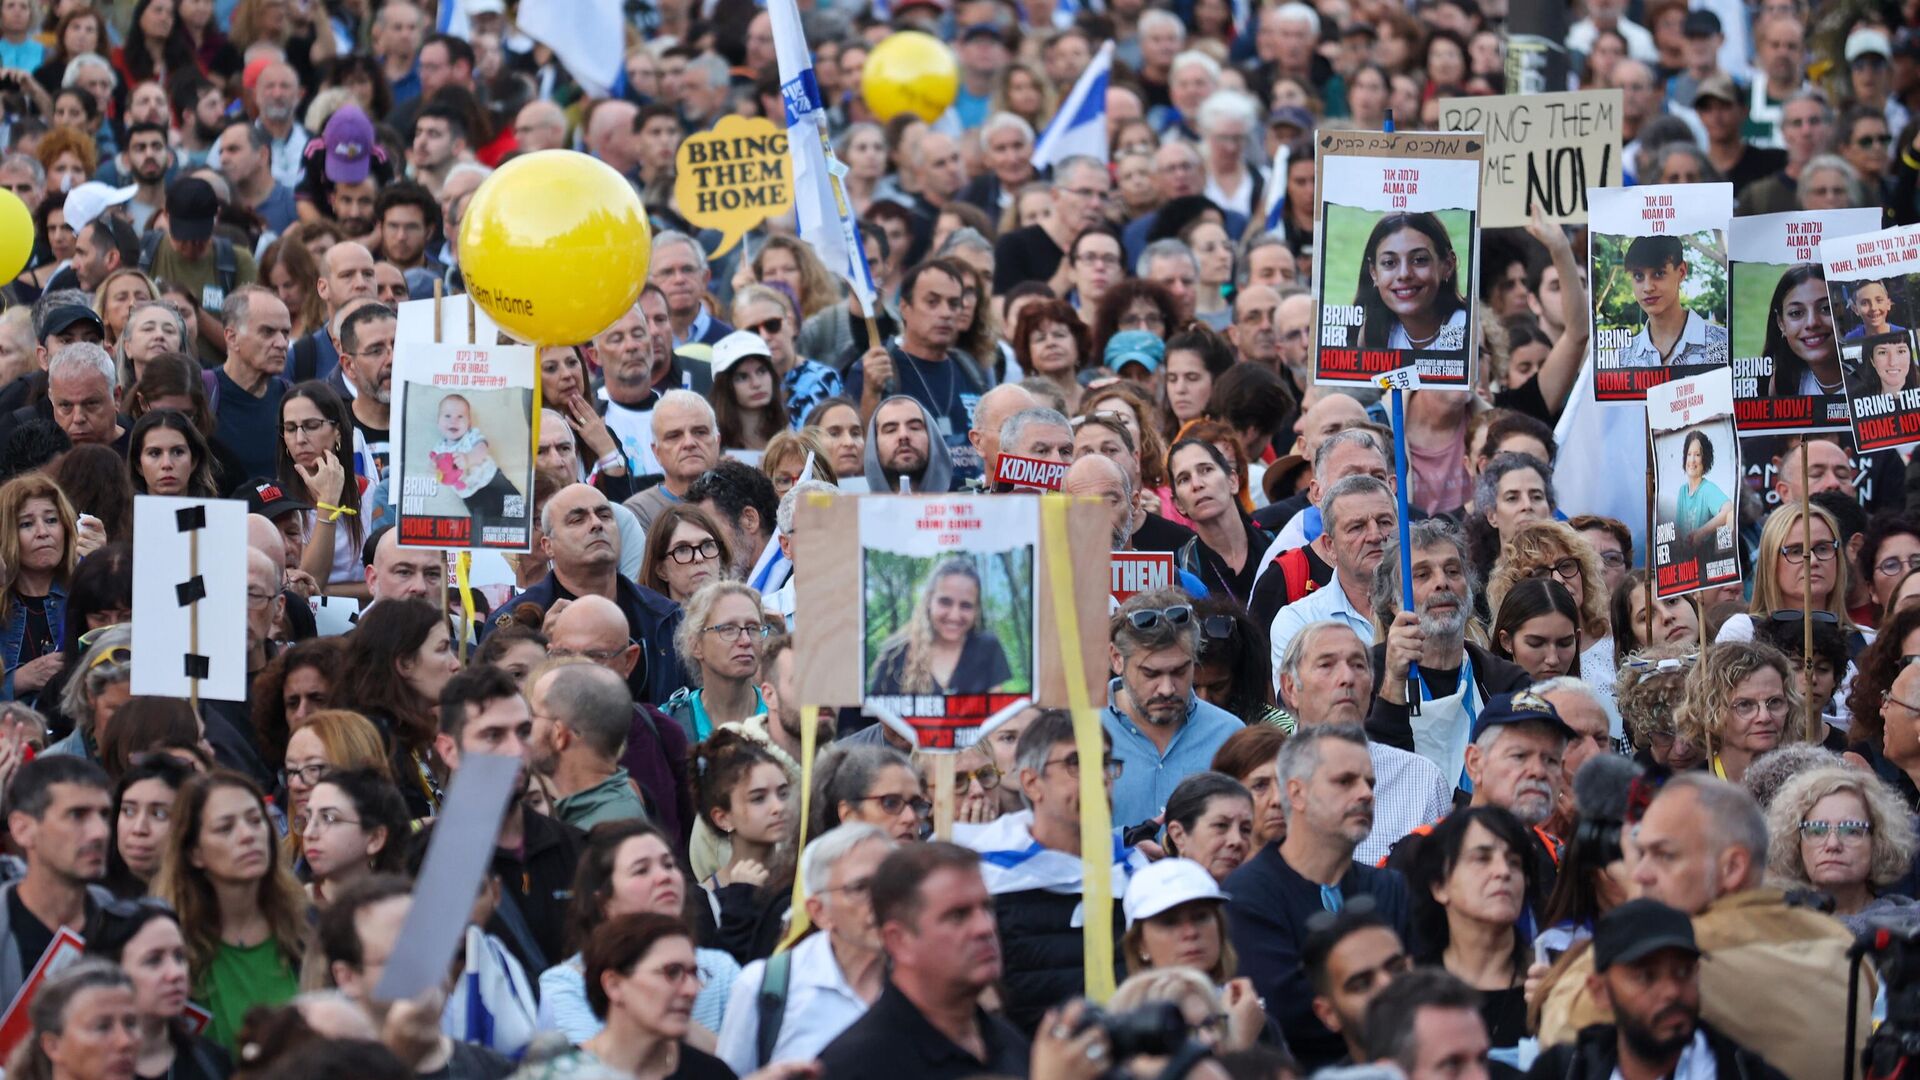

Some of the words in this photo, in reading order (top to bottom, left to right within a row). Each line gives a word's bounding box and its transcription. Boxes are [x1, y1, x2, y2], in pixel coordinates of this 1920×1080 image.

[1545, 102, 1613, 139] THEM
[687, 133, 788, 164] BRING
[1369, 136, 1402, 150] לכם
[692, 158, 784, 188] THEM
[1383, 168, 1396, 181] אור
[1398, 169, 1419, 181] עלמה
[1485, 154, 1516, 186] ME
[697, 183, 788, 213] HOME
[1382, 182, 1405, 194] ALMA
[1406, 183, 1418, 195] OR
[1392, 196, 1407, 208] (13)
[1644, 195, 1657, 207] אור
[1642, 208, 1664, 220] NOAM
[1665, 208, 1676, 219] OR
[1652, 220, 1665, 233] (17)
[1785, 222, 1799, 234] אור
[1801, 221, 1823, 234] עלמה
[1786, 235, 1809, 247] ALMA
[1796, 248, 1812, 261] (13)
[1829, 261, 1857, 274] YAHEL,
[1857, 253, 1886, 270] NAVEH,
[1886, 251, 1901, 264] TAL
[1902, 248, 1918, 261] AND
[493, 287, 534, 316] Home
[1322, 303, 1364, 327] BRING
[1321, 324, 1348, 348] HER
[1597, 328, 1632, 349] BRING
[1320, 349, 1358, 371] HOME
[1597, 349, 1620, 369] HIM
[1733, 356, 1773, 378] BRING
[1442, 366, 1464, 377] FORUM
[1597, 371, 1631, 391] HOME
[1733, 378, 1759, 399] HER
[1734, 400, 1770, 420] HOME
[1773, 395, 1814, 419] NOW!
[1853, 392, 1896, 419] BRING
[1896, 387, 1920, 411] THE
[1827, 409, 1850, 419] FAMILIE
[1858, 416, 1898, 441] HOME
[1898, 411, 1920, 434] NO
[402, 477, 438, 497] BRING
[401, 496, 424, 516] HIM
[401, 517, 433, 537] HOME
[436, 516, 471, 538] NOW!
[1656, 522, 1676, 545] BRING
[1656, 544, 1671, 566] HER
[1111, 560, 1168, 592] THEM
[1657, 565, 1678, 587] HOME
[1678, 556, 1699, 582] NOW!
